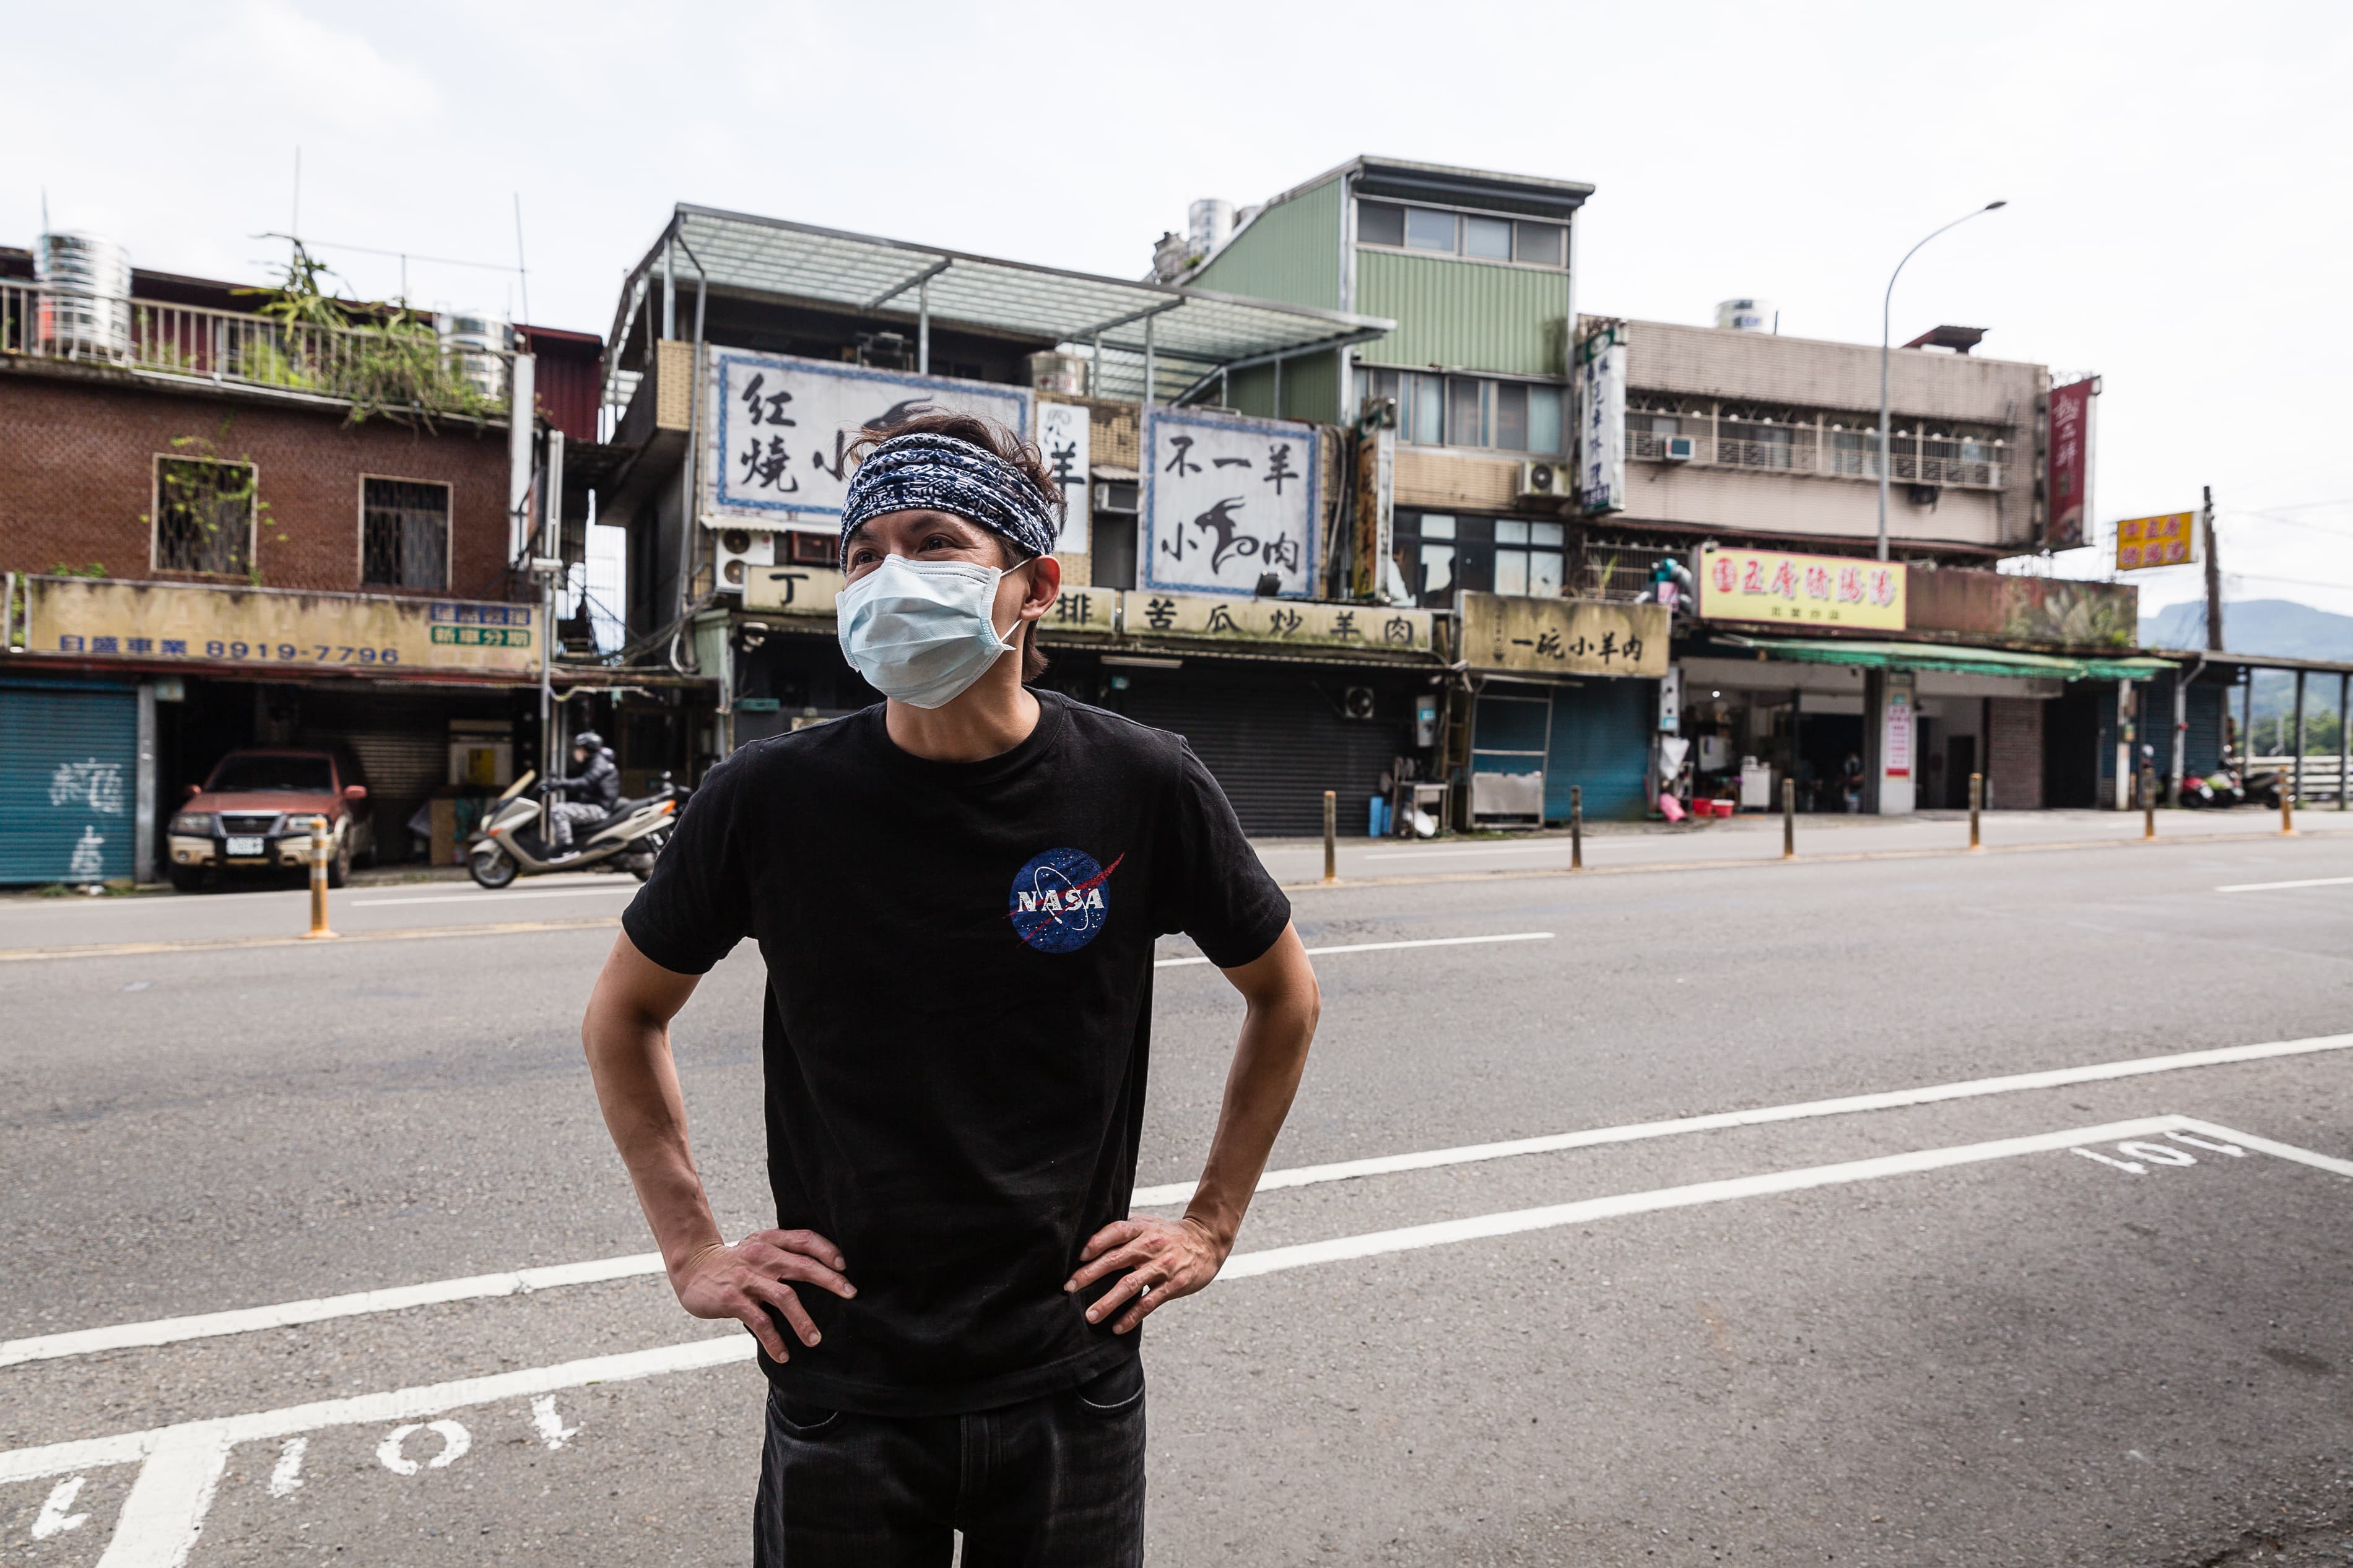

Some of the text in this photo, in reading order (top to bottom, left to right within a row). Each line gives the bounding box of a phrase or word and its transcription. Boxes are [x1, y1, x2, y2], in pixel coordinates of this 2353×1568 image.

[741, 373, 798, 492] 紅燒
[1165, 436, 1299, 495] 不一羊
[1144, 599, 1414, 646] 苦瓜炒羊肉
[206, 640, 399, 665] 8919-7796
[1511, 627, 1643, 664] 一碗小羊肉
[1017, 888, 1105, 912] NASA
